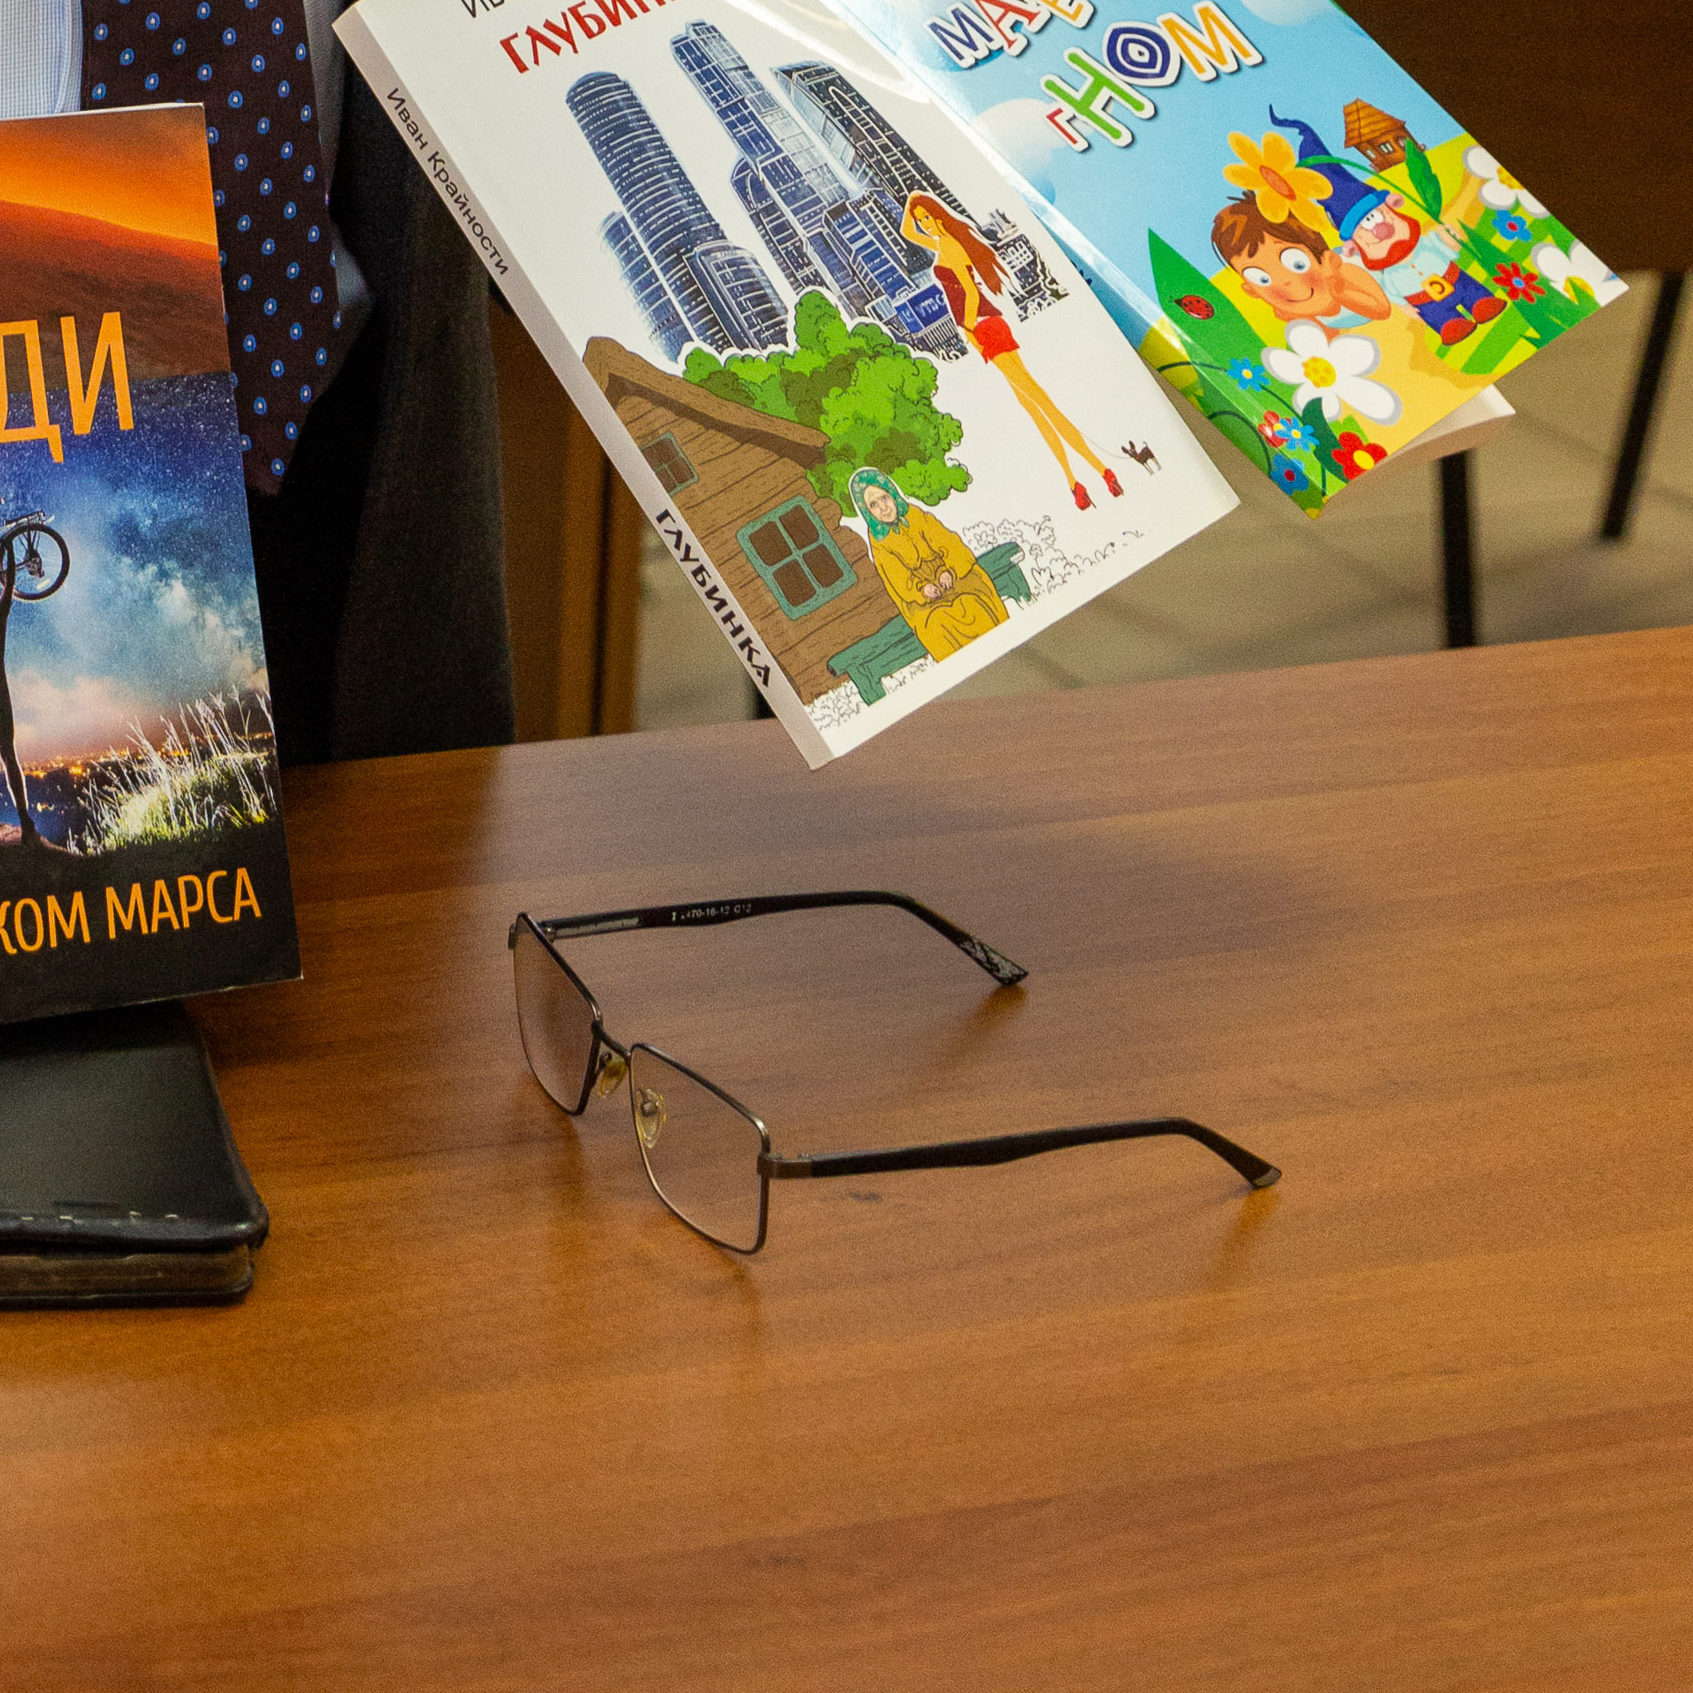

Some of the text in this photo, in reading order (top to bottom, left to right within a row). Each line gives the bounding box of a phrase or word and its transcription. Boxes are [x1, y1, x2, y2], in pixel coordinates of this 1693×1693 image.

[385, 86, 510, 277] Иван Крайности
[655, 508, 772, 689] ГЛУБИНКА
[104, 866, 263, 941] МАРСА
